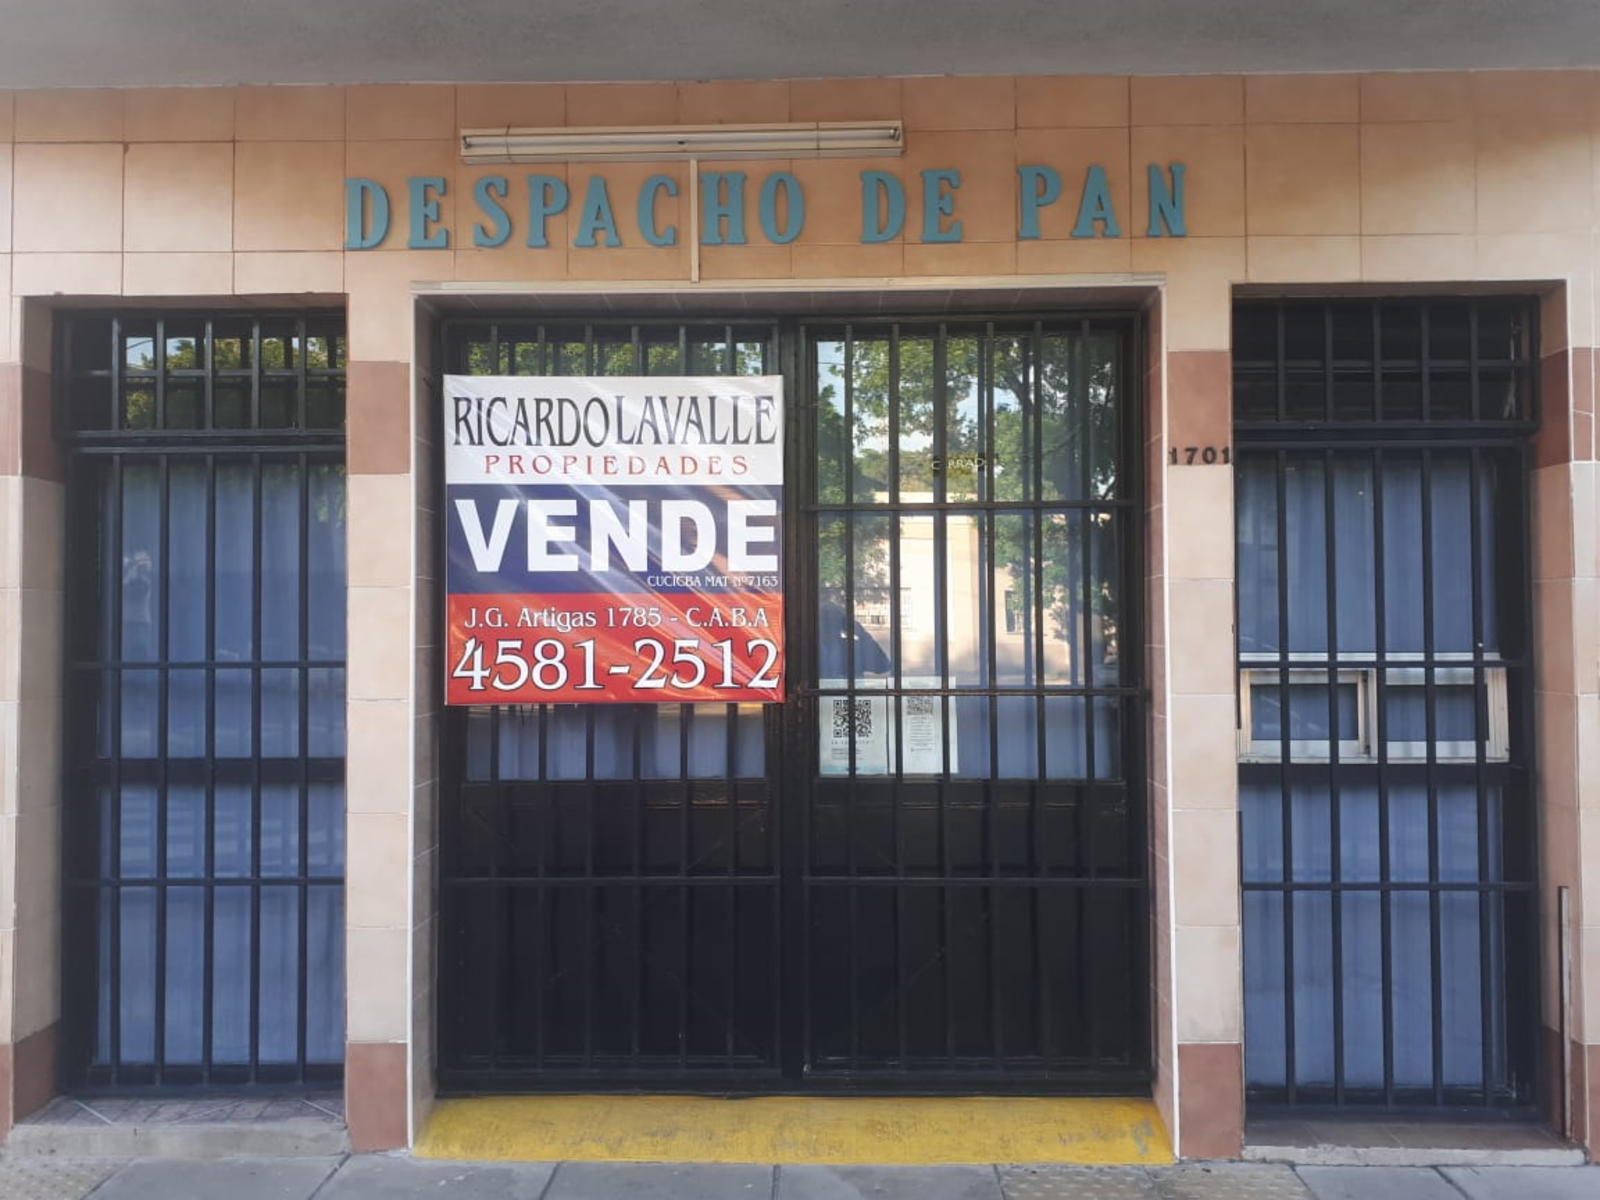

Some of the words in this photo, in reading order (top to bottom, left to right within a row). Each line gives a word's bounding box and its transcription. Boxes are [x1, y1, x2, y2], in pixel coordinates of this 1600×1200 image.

[344, 171, 806, 250] DESPACHO
[860, 169, 962, 243] DE
[1016, 163, 1187, 239] PAN
[484, 454, 749, 475] PROPIEDADES
[1169, 446, 1230, 466] 1701
[455, 499, 779, 572] VENDE
[704, 575, 729, 587] MAT
[464, 607, 508, 628] J.G.
[516, 606, 597, 632] Artigas
[606, 606, 662, 627] 1785
[686, 607, 769, 628] C.A.B.A
[452, 637, 781, 690] 4581-2512
